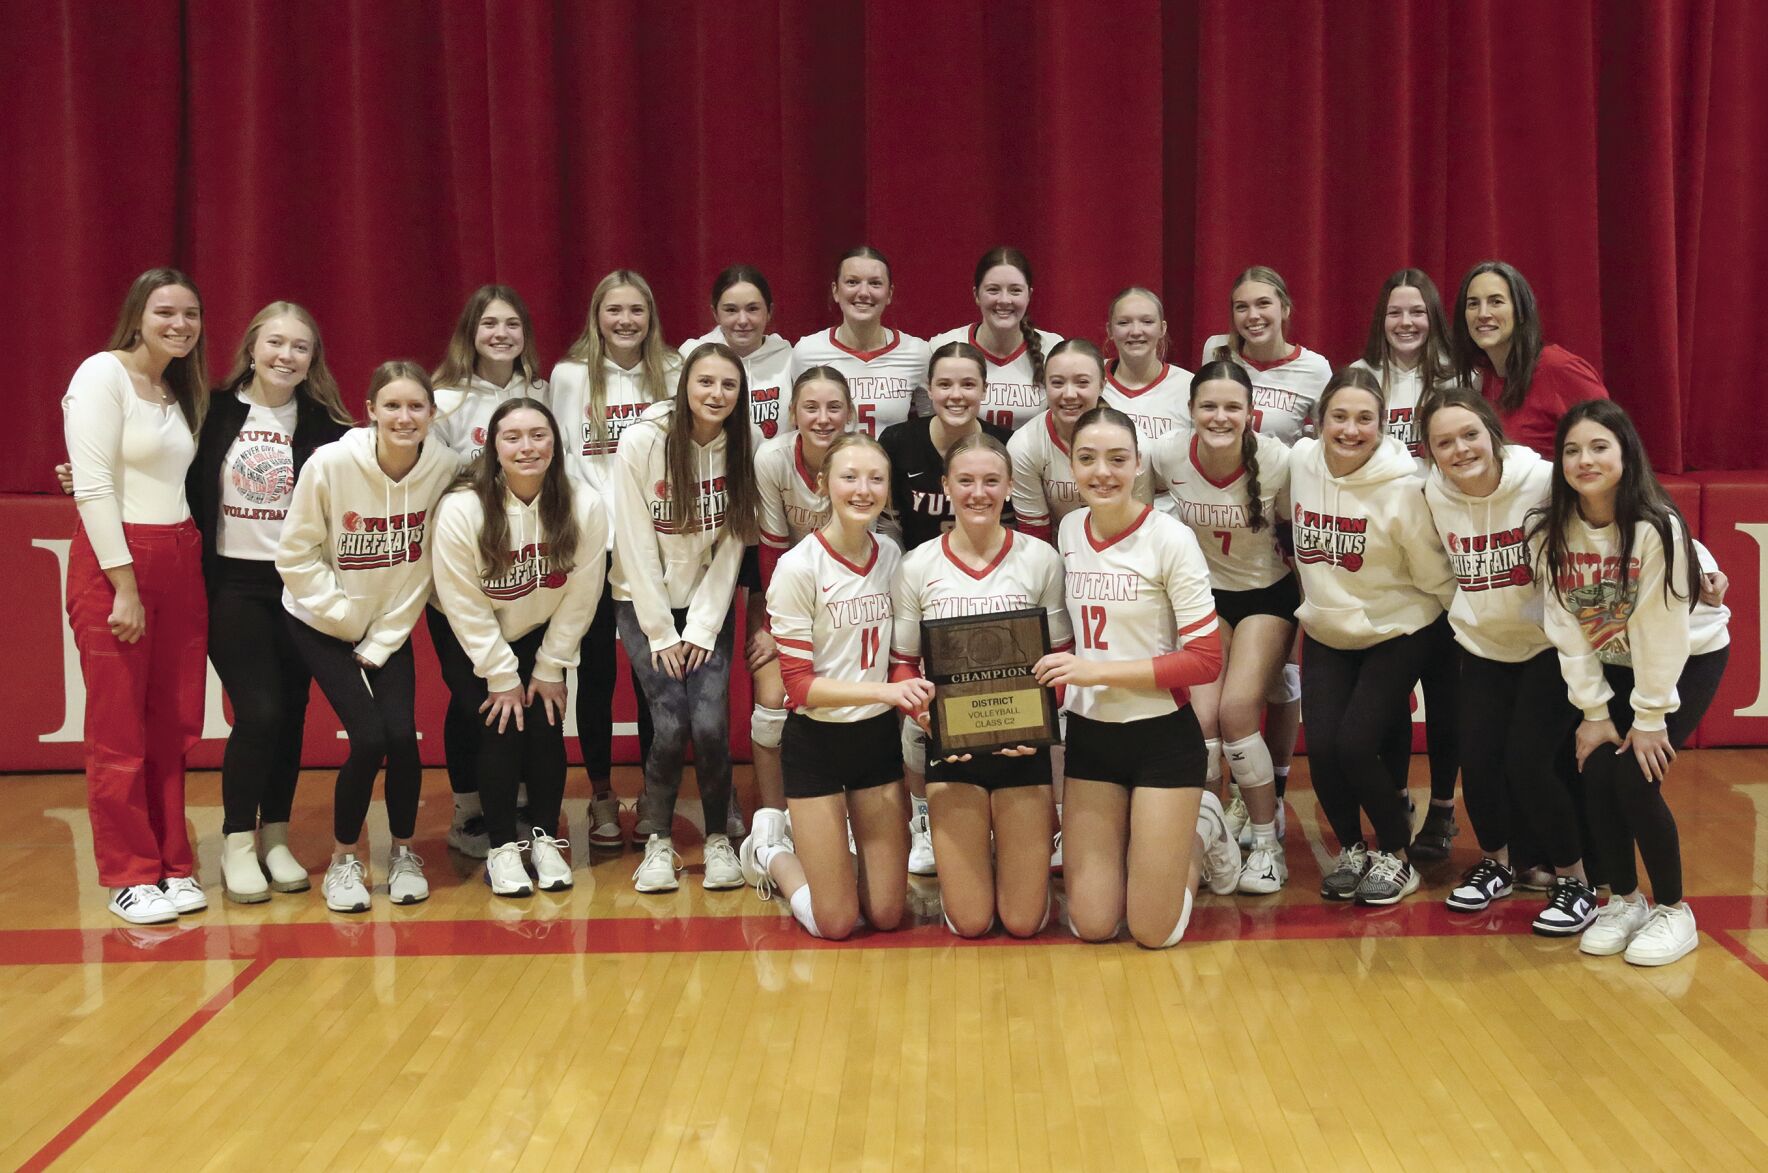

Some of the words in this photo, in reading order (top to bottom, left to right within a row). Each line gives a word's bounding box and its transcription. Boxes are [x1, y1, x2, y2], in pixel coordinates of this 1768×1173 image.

[858, 404, 875, 439] 5
[1178, 498, 1250, 528] YUTA
[1213, 531, 1232, 556] 7
[1081, 605, 1108, 651] 12
[861, 626, 879, 670] 11
[951, 666, 1028, 684] CHAMPION
[968, 707, 1021, 719] VOLLEYBALL
[972, 696, 1014, 708] DISTRICT
[975, 718, 1003, 728] CLASS
[1004, 717, 1015, 726] C2
